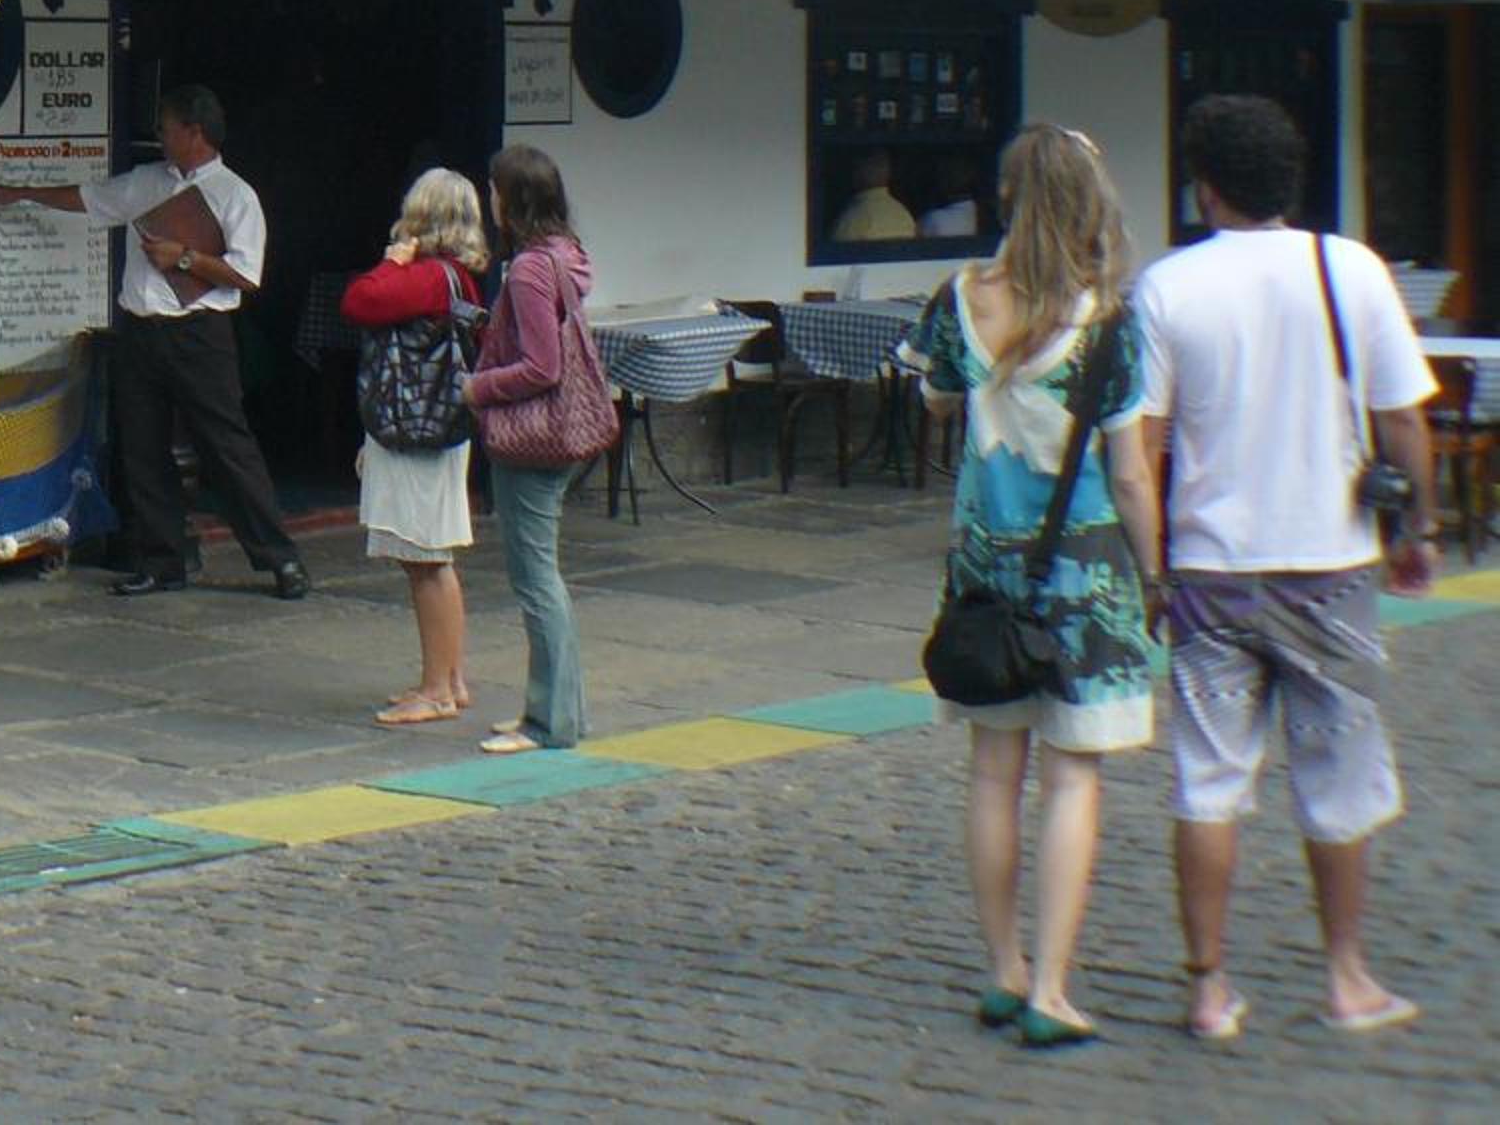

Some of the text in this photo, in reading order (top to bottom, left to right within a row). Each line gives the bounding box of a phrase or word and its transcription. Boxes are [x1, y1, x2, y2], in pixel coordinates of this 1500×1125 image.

[29, 50, 105, 68] DOLLAR
[41, 92, 93, 108] EURO
[61, 141, 71, 158] 2
